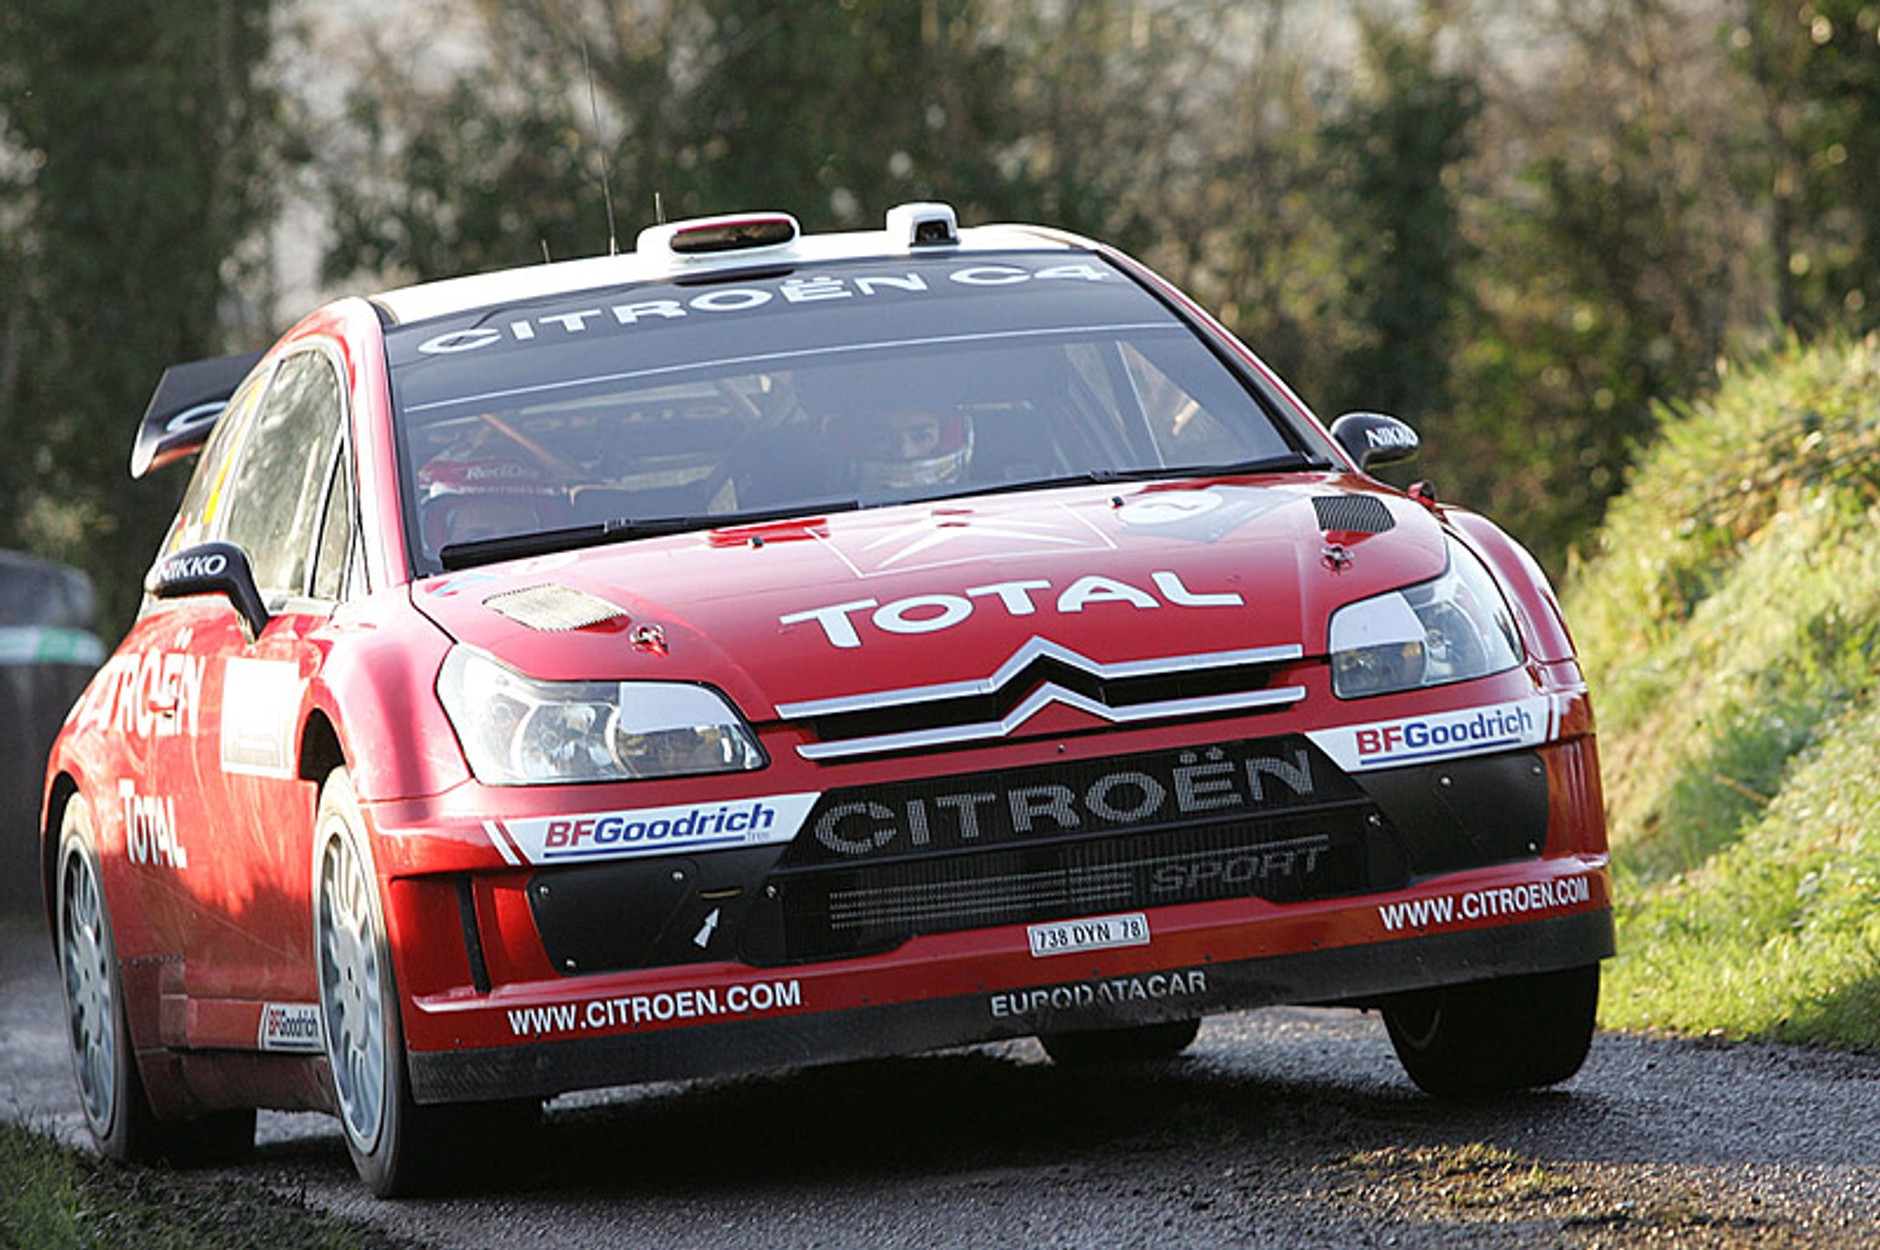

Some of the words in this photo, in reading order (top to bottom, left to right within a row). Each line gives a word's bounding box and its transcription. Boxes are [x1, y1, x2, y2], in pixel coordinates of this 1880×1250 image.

[417, 273, 926, 354] CITROËN
[949, 264, 1109, 286] C4
[779, 571, 1245, 650] TOTAL
[1356, 705, 1533, 755] BFGoodrich
[118, 777, 188, 869] TOTAL
[545, 803, 775, 848] BFGoodrich
[814, 747, 1315, 855] CITROËN
[1151, 842, 1330, 892] SPORT
[1379, 876, 1590, 931] WWW.CITROEN.COM
[1072, 922, 1112, 944] DYN
[507, 980, 801, 1037] WWW.CITROEN.COM
